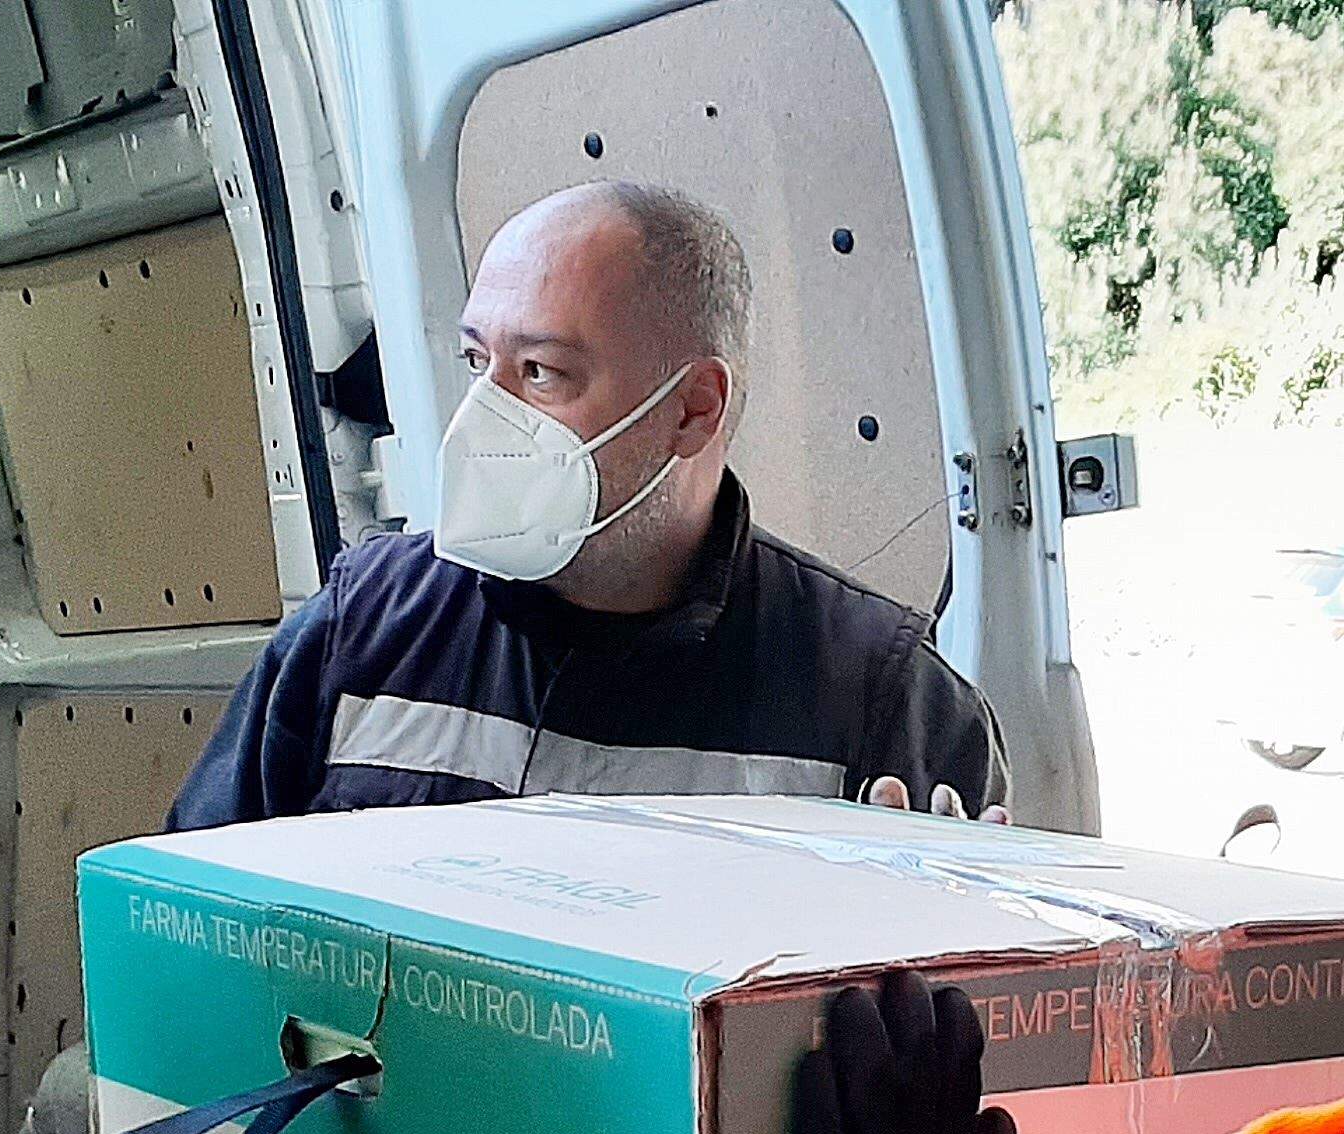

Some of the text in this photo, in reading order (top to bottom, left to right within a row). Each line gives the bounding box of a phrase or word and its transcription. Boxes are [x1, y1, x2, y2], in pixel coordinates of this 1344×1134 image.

[128, 895, 613, 1059] FARMA TEMPERATURA CONTROLADA
